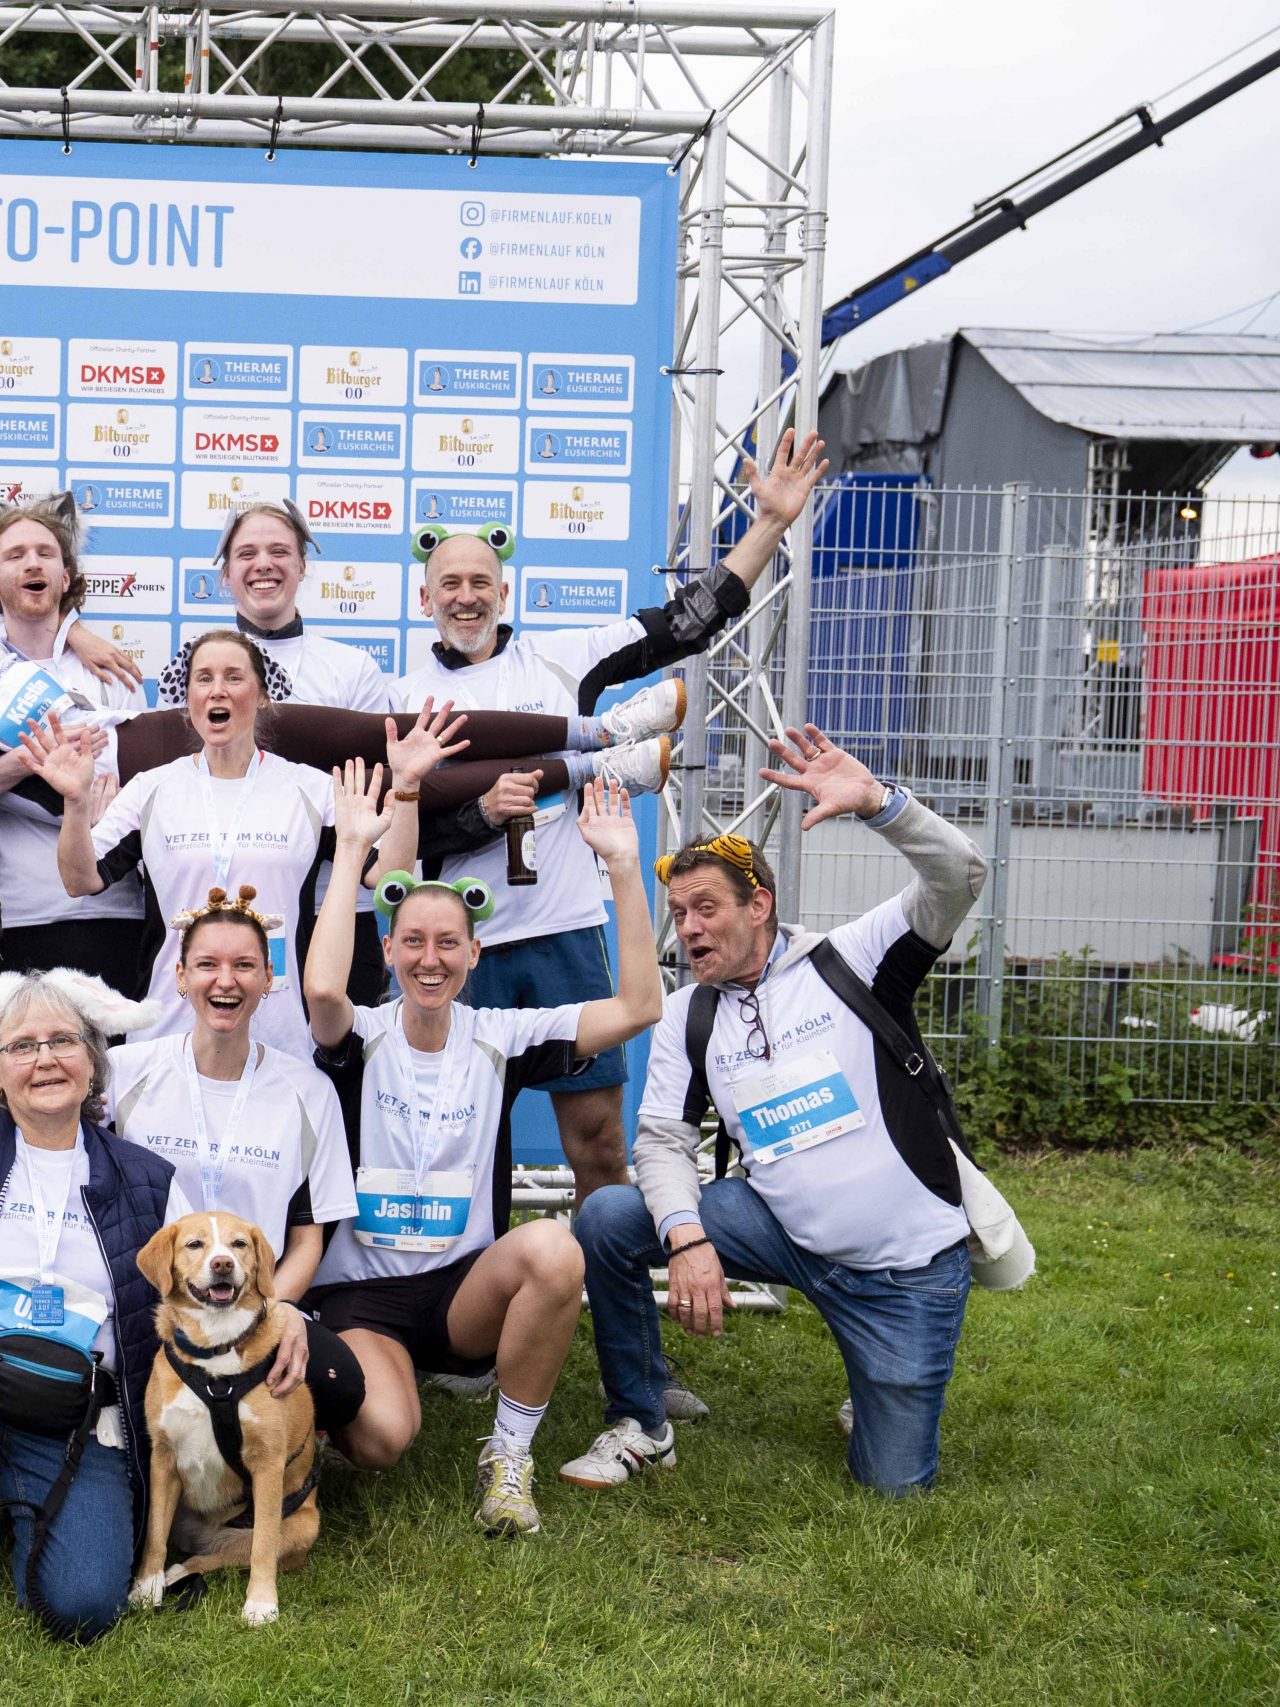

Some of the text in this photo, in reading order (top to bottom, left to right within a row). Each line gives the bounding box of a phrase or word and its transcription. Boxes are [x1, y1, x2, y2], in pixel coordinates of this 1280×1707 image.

[490, 208, 612, 225] @FIRMENLAUF.KOELN
[489, 242, 605, 259] @FIRMENLAUF KÖLN
[488, 275, 604, 292] @FIRMENLAUF KÖLN
[81, 364, 144, 384] DKMS
[225, 362, 281, 374] THERME
[454, 368, 510, 381] THERME
[224, 374, 282, 384] EUSKIRCHEN
[326, 367, 382, 388] Bitburger
[568, 372, 622, 384] THERME
[453, 381, 510, 391] EUSKIRCHEN
[566, 384, 623, 394] EUSKIRCHEN
[93, 424, 150, 445] Bitburger
[338, 430, 394, 442] THERME
[195, 432, 259, 452] DKMS
[338, 442, 394, 452] EUSKIRCHEN
[438, 434, 494, 455] Bitburger
[565, 436, 620, 448] THERME
[242, 454, 278, 462] BLUTKREBS
[564, 448, 621, 458] EUSKIRCHEN
[106, 488, 162, 500] THERME
[106, 500, 164, 510] EUSKIRCHEN
[450, 496, 506, 509] THERME
[308, 500, 372, 520] DKMS
[450, 509, 506, 519] EUSKIRCHEN
[550, 502, 604, 522] Bitburger
[86, 574, 166, 598] EPPEX SPORTS
[320, 582, 376, 602] Bitburger
[560, 586, 616, 597] THERME
[560, 598, 616, 607] EUSKIRCHEN
[514, 700, 544, 712] KÖLN
[164, 832, 288, 844] VET KÖLN
[796, 1012, 832, 1035] KÖLN
[780, 1022, 836, 1050] für Kleintiere
[377, 1090, 399, 1106] VET
[751, 1086, 835, 1130] Thomas
[789, 1119, 812, 1136] 2171
[146, 1135, 280, 1161] VET ZENRM KÖLN
[240, 1156, 280, 1170] Kleintiere
[10, 1202, 78, 1222] ZENRM
[64, 1221, 77, 1229] für
